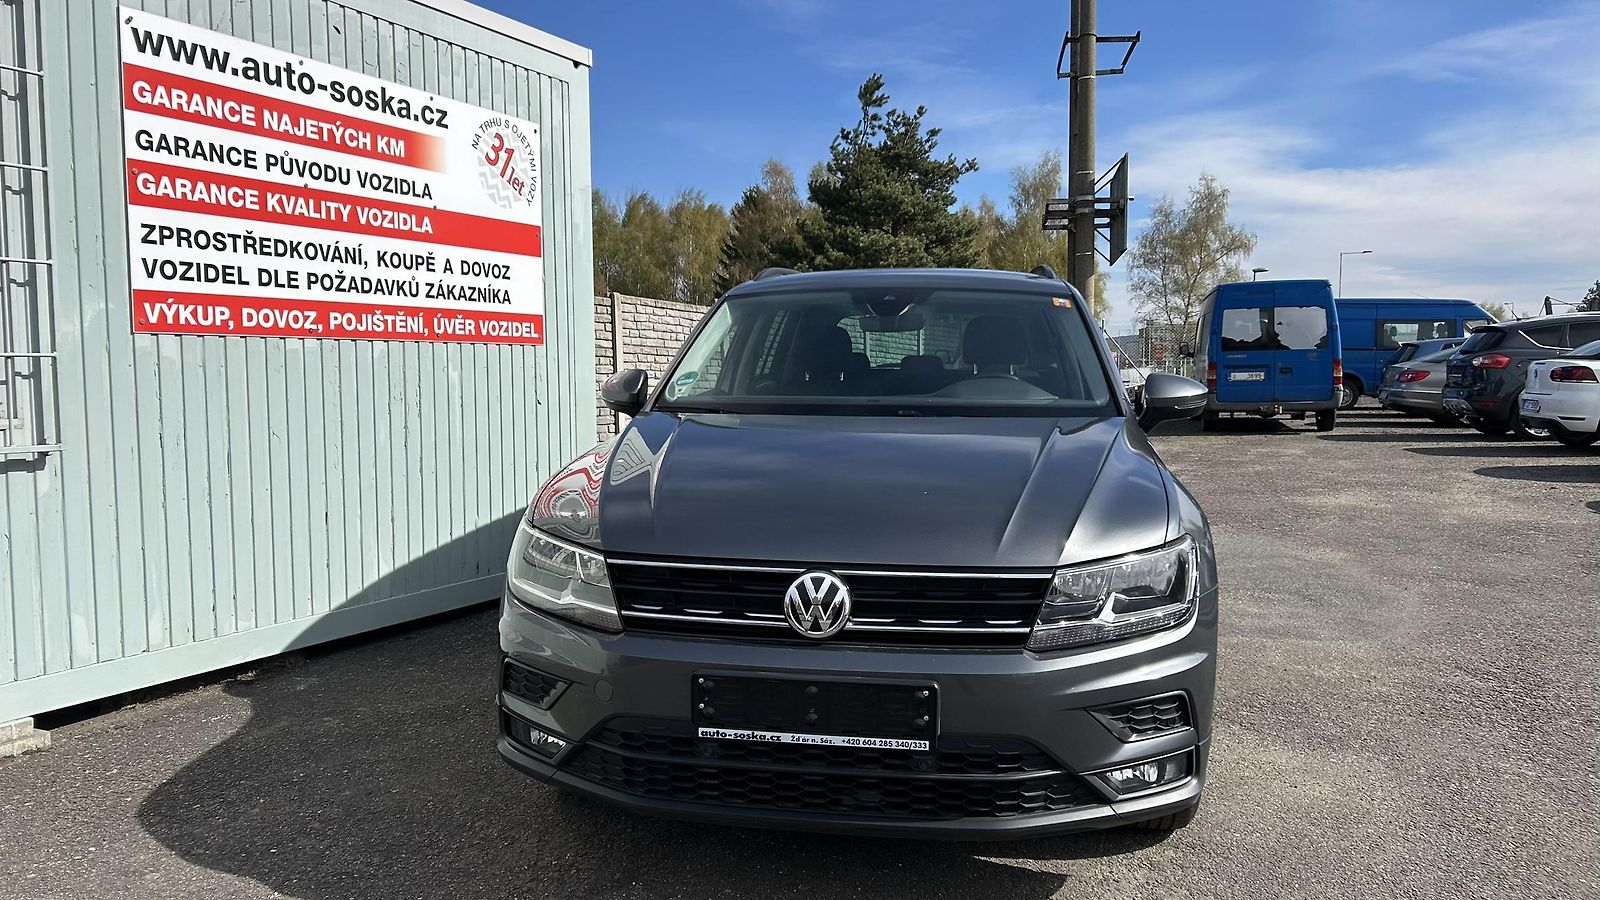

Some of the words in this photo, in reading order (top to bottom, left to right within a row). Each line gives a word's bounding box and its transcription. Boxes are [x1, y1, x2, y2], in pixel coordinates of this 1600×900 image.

[131, 27, 449, 129] www.auto-soska.cz
[132, 80, 256, 126] GARANCE
[263, 109, 371, 150] NAJETÝCH
[377, 136, 405, 158] KM
[135, 129, 258, 170] GARANCE
[265, 150, 351, 187] PŮVODU
[356, 171, 433, 200] VOZIDLA
[471, 133, 482, 150] NA
[479, 117, 502, 134] TRHU
[504, 119, 510, 129] S
[511, 124, 537, 172] OJETÝMI
[526, 176, 537, 207] VOZY
[485, 132, 515, 178] 31
[506, 166, 525, 196] let
[136, 172, 260, 210] GARANCE
[266, 189, 351, 223] KVALITY
[356, 207, 433, 234] VOZIDLA
[140, 222, 368, 269] ZPROSTŘEDKOVÁNÍ,
[376, 250, 436, 272] KOUPĚ
[443, 258, 454, 274] A
[460, 260, 511, 280] DOVOZ
[140, 257, 250, 286] VOZIDEL
[257, 267, 299, 290] DLE
[306, 270, 419, 298] POŽADAVKŮ
[425, 279, 511, 305] ZÁKAZNÍKA
[143, 298, 234, 331] VÝKUP,
[242, 307, 323, 333] DOVOZ,
[329, 308, 428, 337] POJIŠTĚNÍ,
[433, 313, 476, 335] ÚVĚR
[479, 320, 539, 338] VOZIDEL
[700, 730, 782, 742] auto-soska.cz
[841, 739, 860, 747] +420
[862, 739, 877, 747] 604
[878, 740, 893, 748] 285
[894, 740, 927, 750] 340/333
